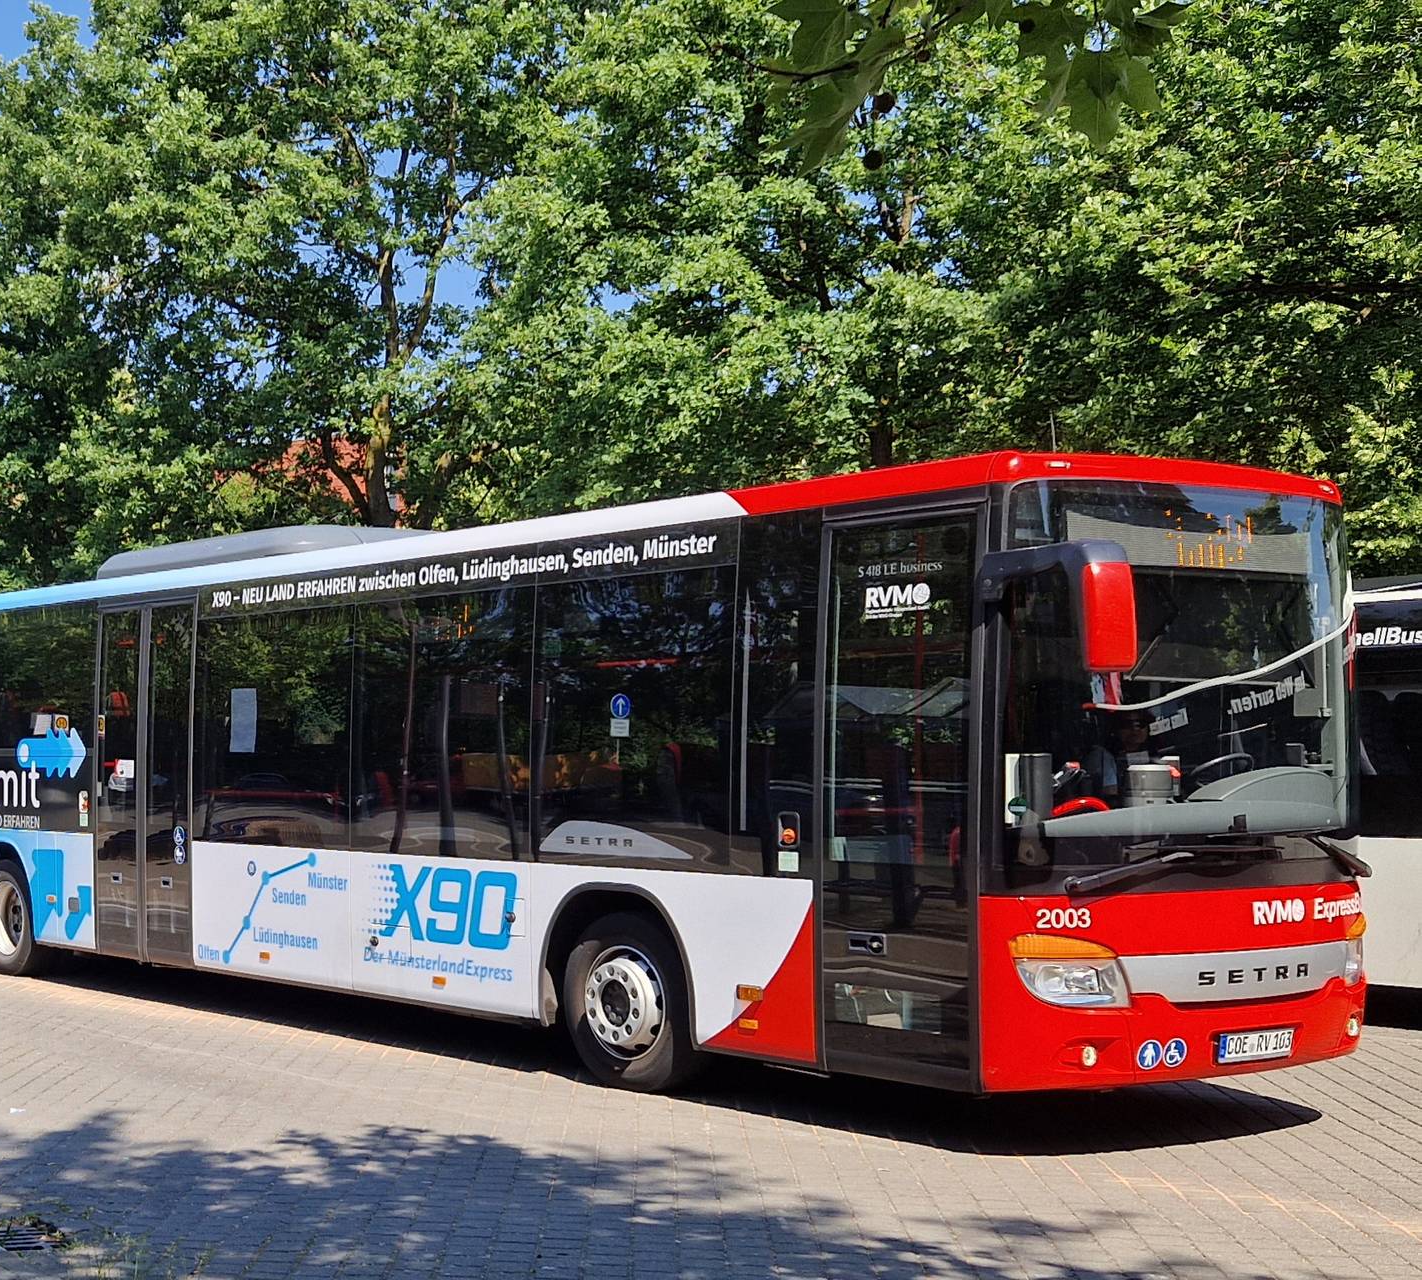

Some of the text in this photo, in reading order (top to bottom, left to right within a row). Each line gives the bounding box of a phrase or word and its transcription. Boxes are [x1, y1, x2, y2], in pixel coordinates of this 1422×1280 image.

[212, 590, 232, 608] X90
[242, 587, 264, 605] NEU
[265, 583, 295, 602] LAND
[297, 575, 356, 599] ERFAHREN
[358, 569, 416, 592] zwischen
[418, 563, 459, 587] Olfen,
[462, 553, 569, 582] Lüdinghausen,
[572, 543, 639, 569] Senden,
[642, 534, 717, 561] Münster
[858, 560, 943, 578] S 418 LE business
[3, 814, 40, 829] ERFAHREN
[565, 835, 633, 848] SETRA
[307, 871, 348, 891] Münster
[272, 887, 307, 906] Senden
[377, 863, 518, 951] X90
[1036, 907, 1091, 929] 2003
[253, 927, 318, 950] Lüdinghausen
[198, 944, 220, 961] Olfen
[363, 946, 513, 983] Der MünsterlandExpress
[1198, 963, 1309, 986] SETRA
[1227, 1031, 1292, 1055] COE RV 103
